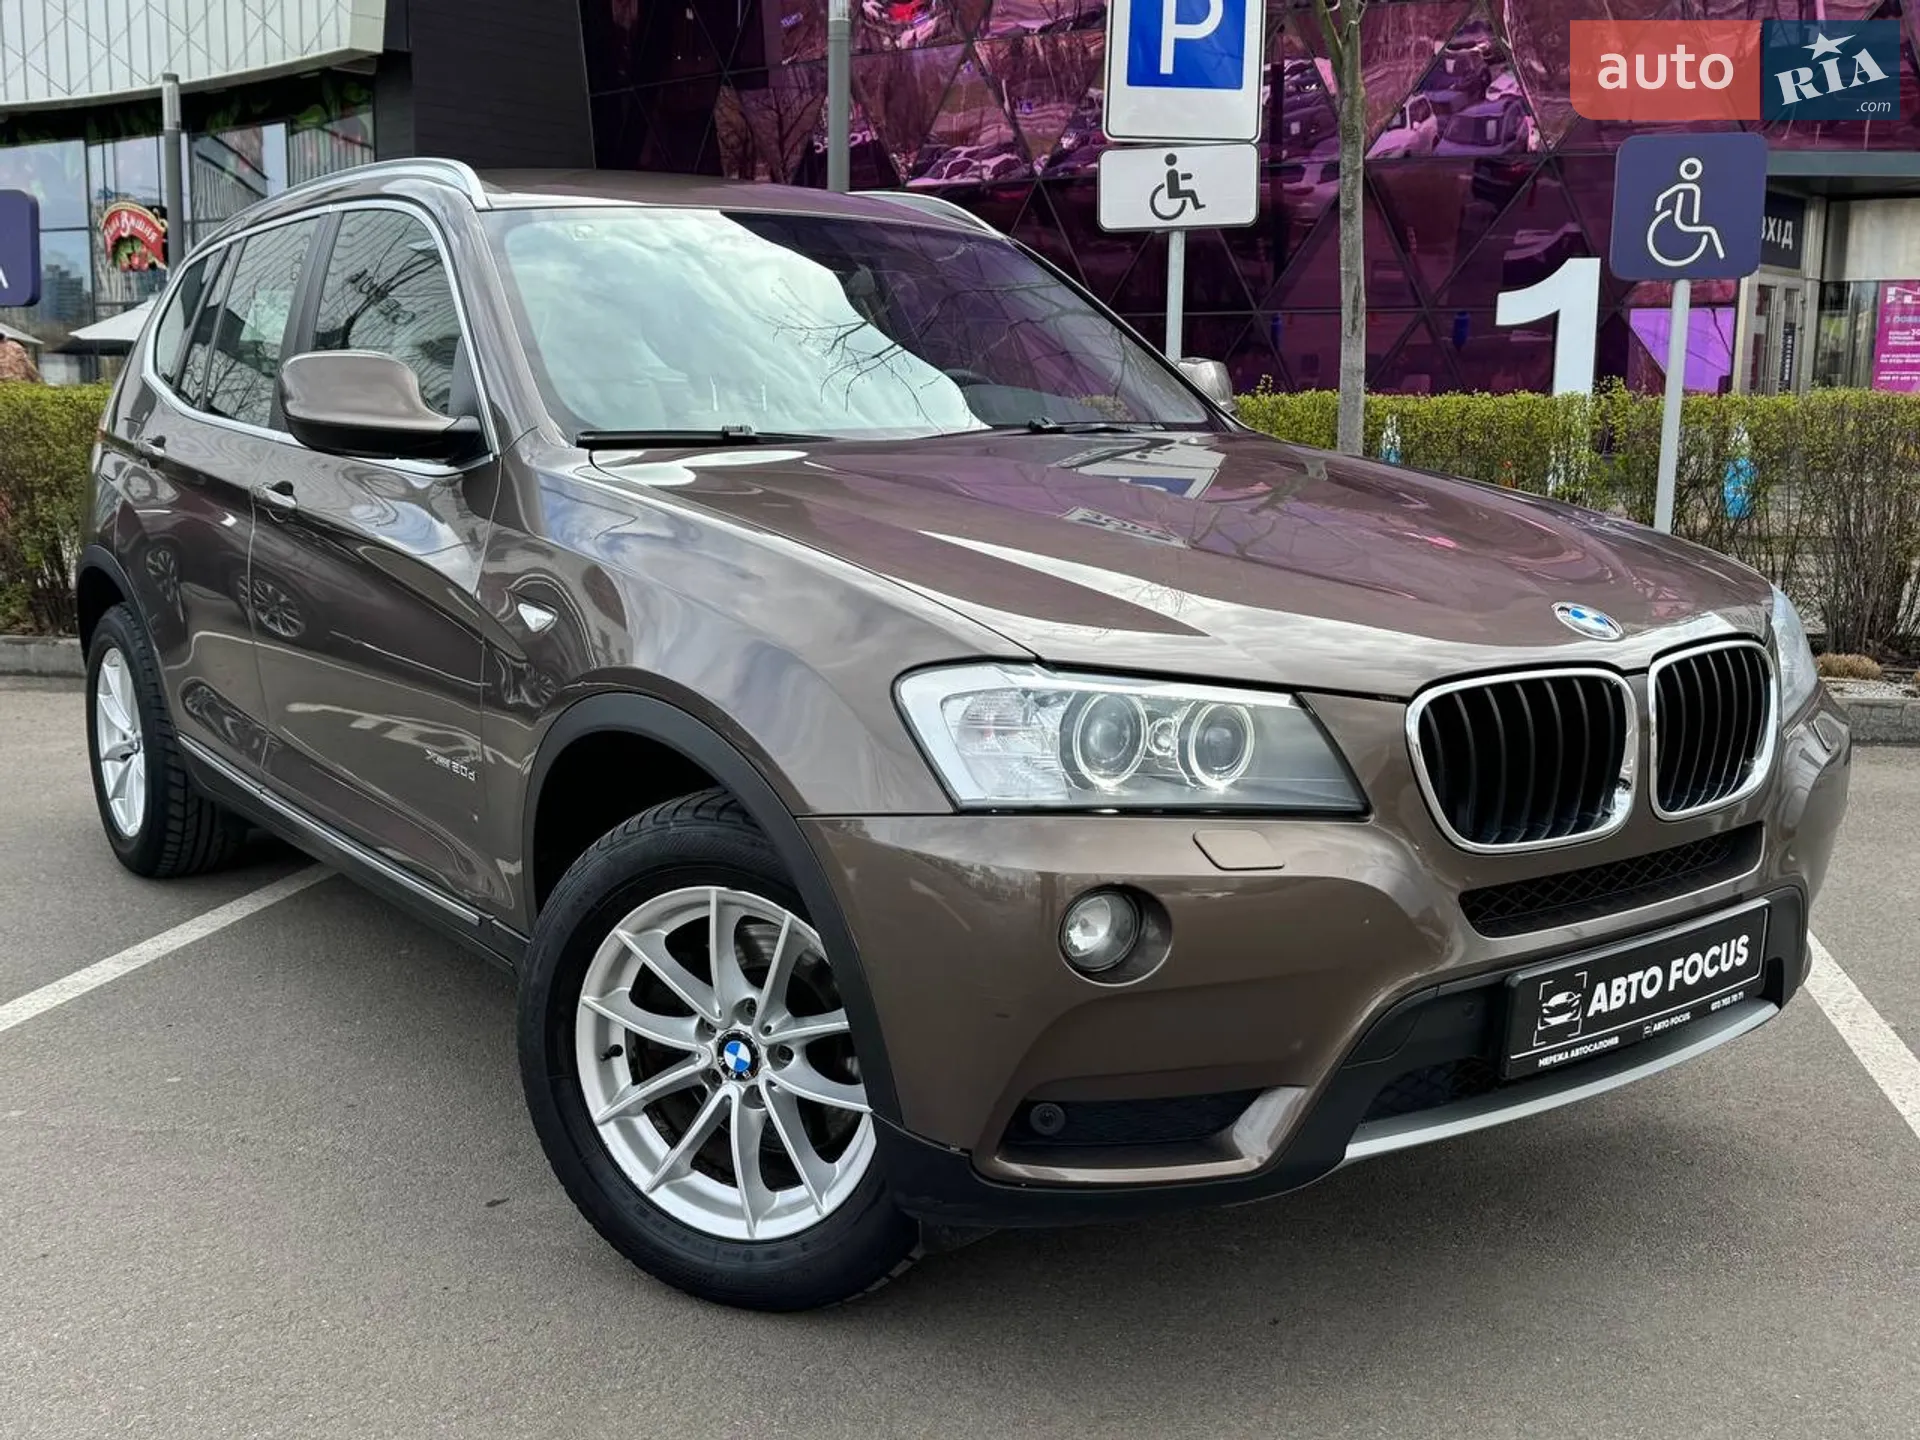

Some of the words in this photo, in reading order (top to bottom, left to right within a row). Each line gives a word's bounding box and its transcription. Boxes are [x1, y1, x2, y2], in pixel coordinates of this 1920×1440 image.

[1160, 0, 1223, 74] P
[1496, 257, 1601, 396] 1
[1586, 965, 1664, 1018] АВТО
[1668, 934, 1750, 992] FOCUS
